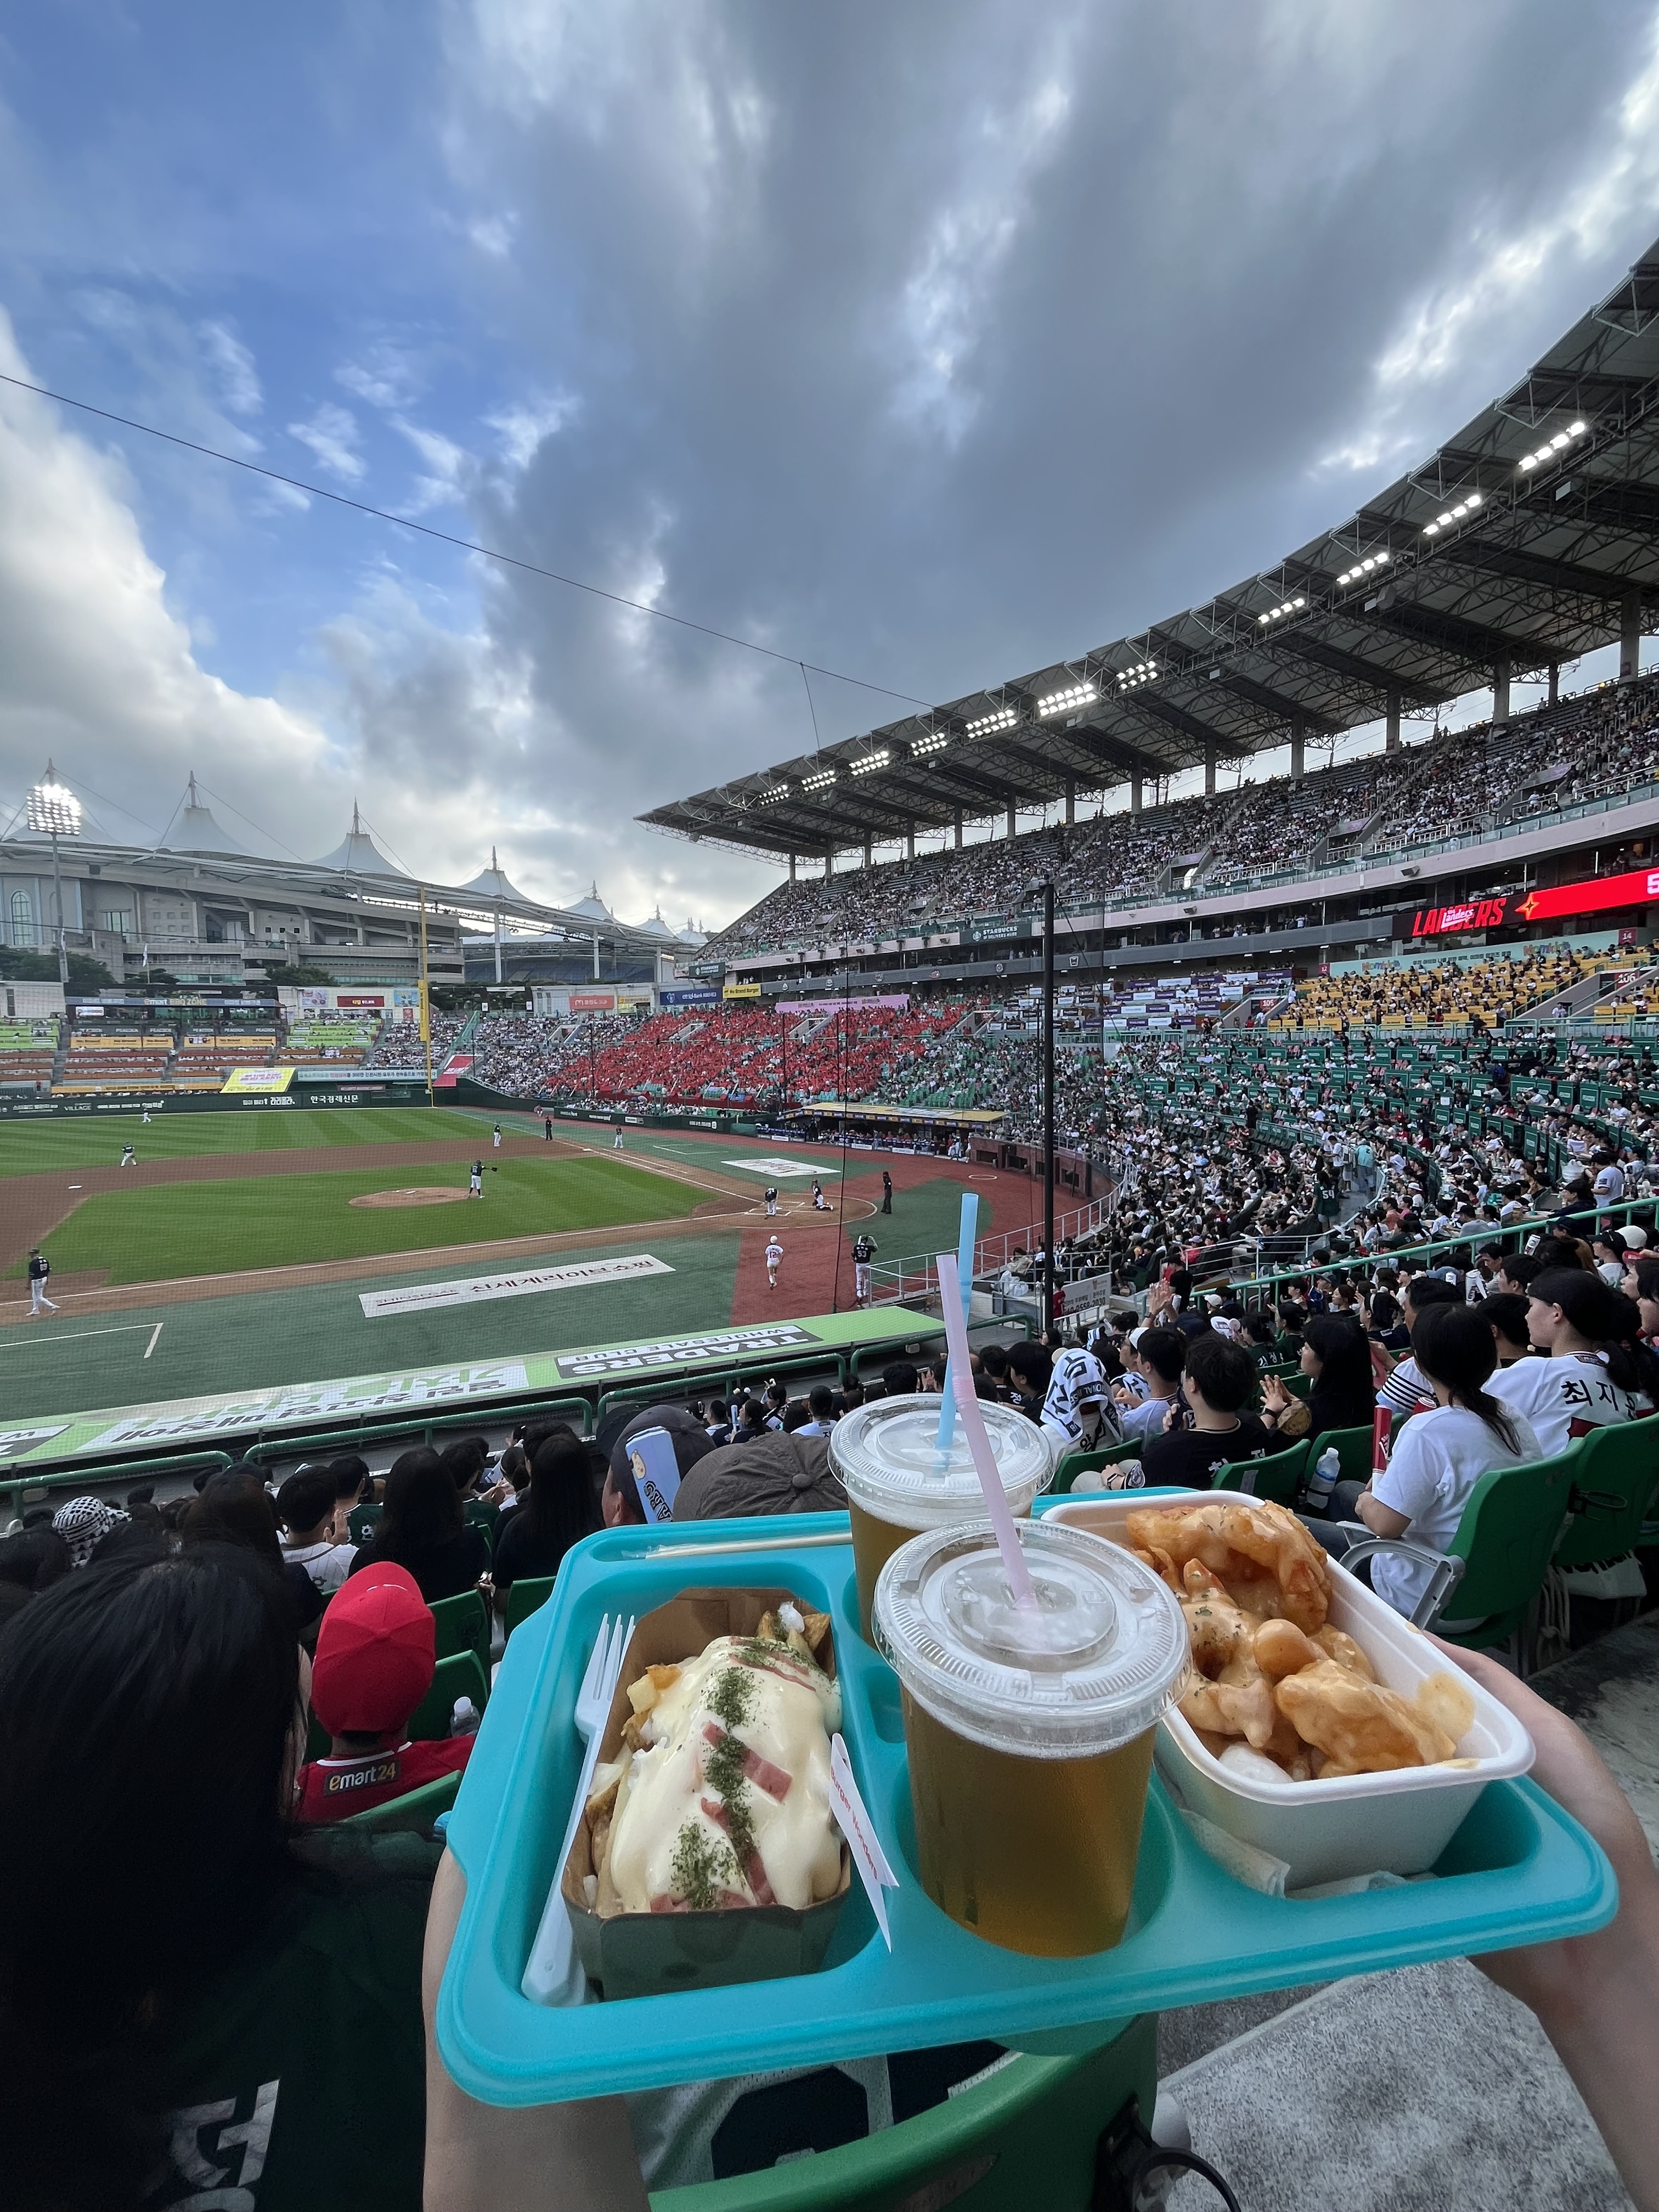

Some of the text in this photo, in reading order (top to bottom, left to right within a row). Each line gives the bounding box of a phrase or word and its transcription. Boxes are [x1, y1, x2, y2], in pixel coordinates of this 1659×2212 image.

[1441, 907, 1475, 929] Landers
[983, 926, 1018, 935] STARBUCKS
[1618, 973, 1637, 984] 106
[311, 1095, 359, 1104] 한국경제신문
[1322, 1190, 1335, 1199] 54
[470, 1260, 654, 1293] 신세계라이브쇼핑
[572, 1335, 809, 1375] TRADERS
[575, 1327, 786, 1361] WHOLESALE CLUB
[329, 1761, 397, 1792] emart24
